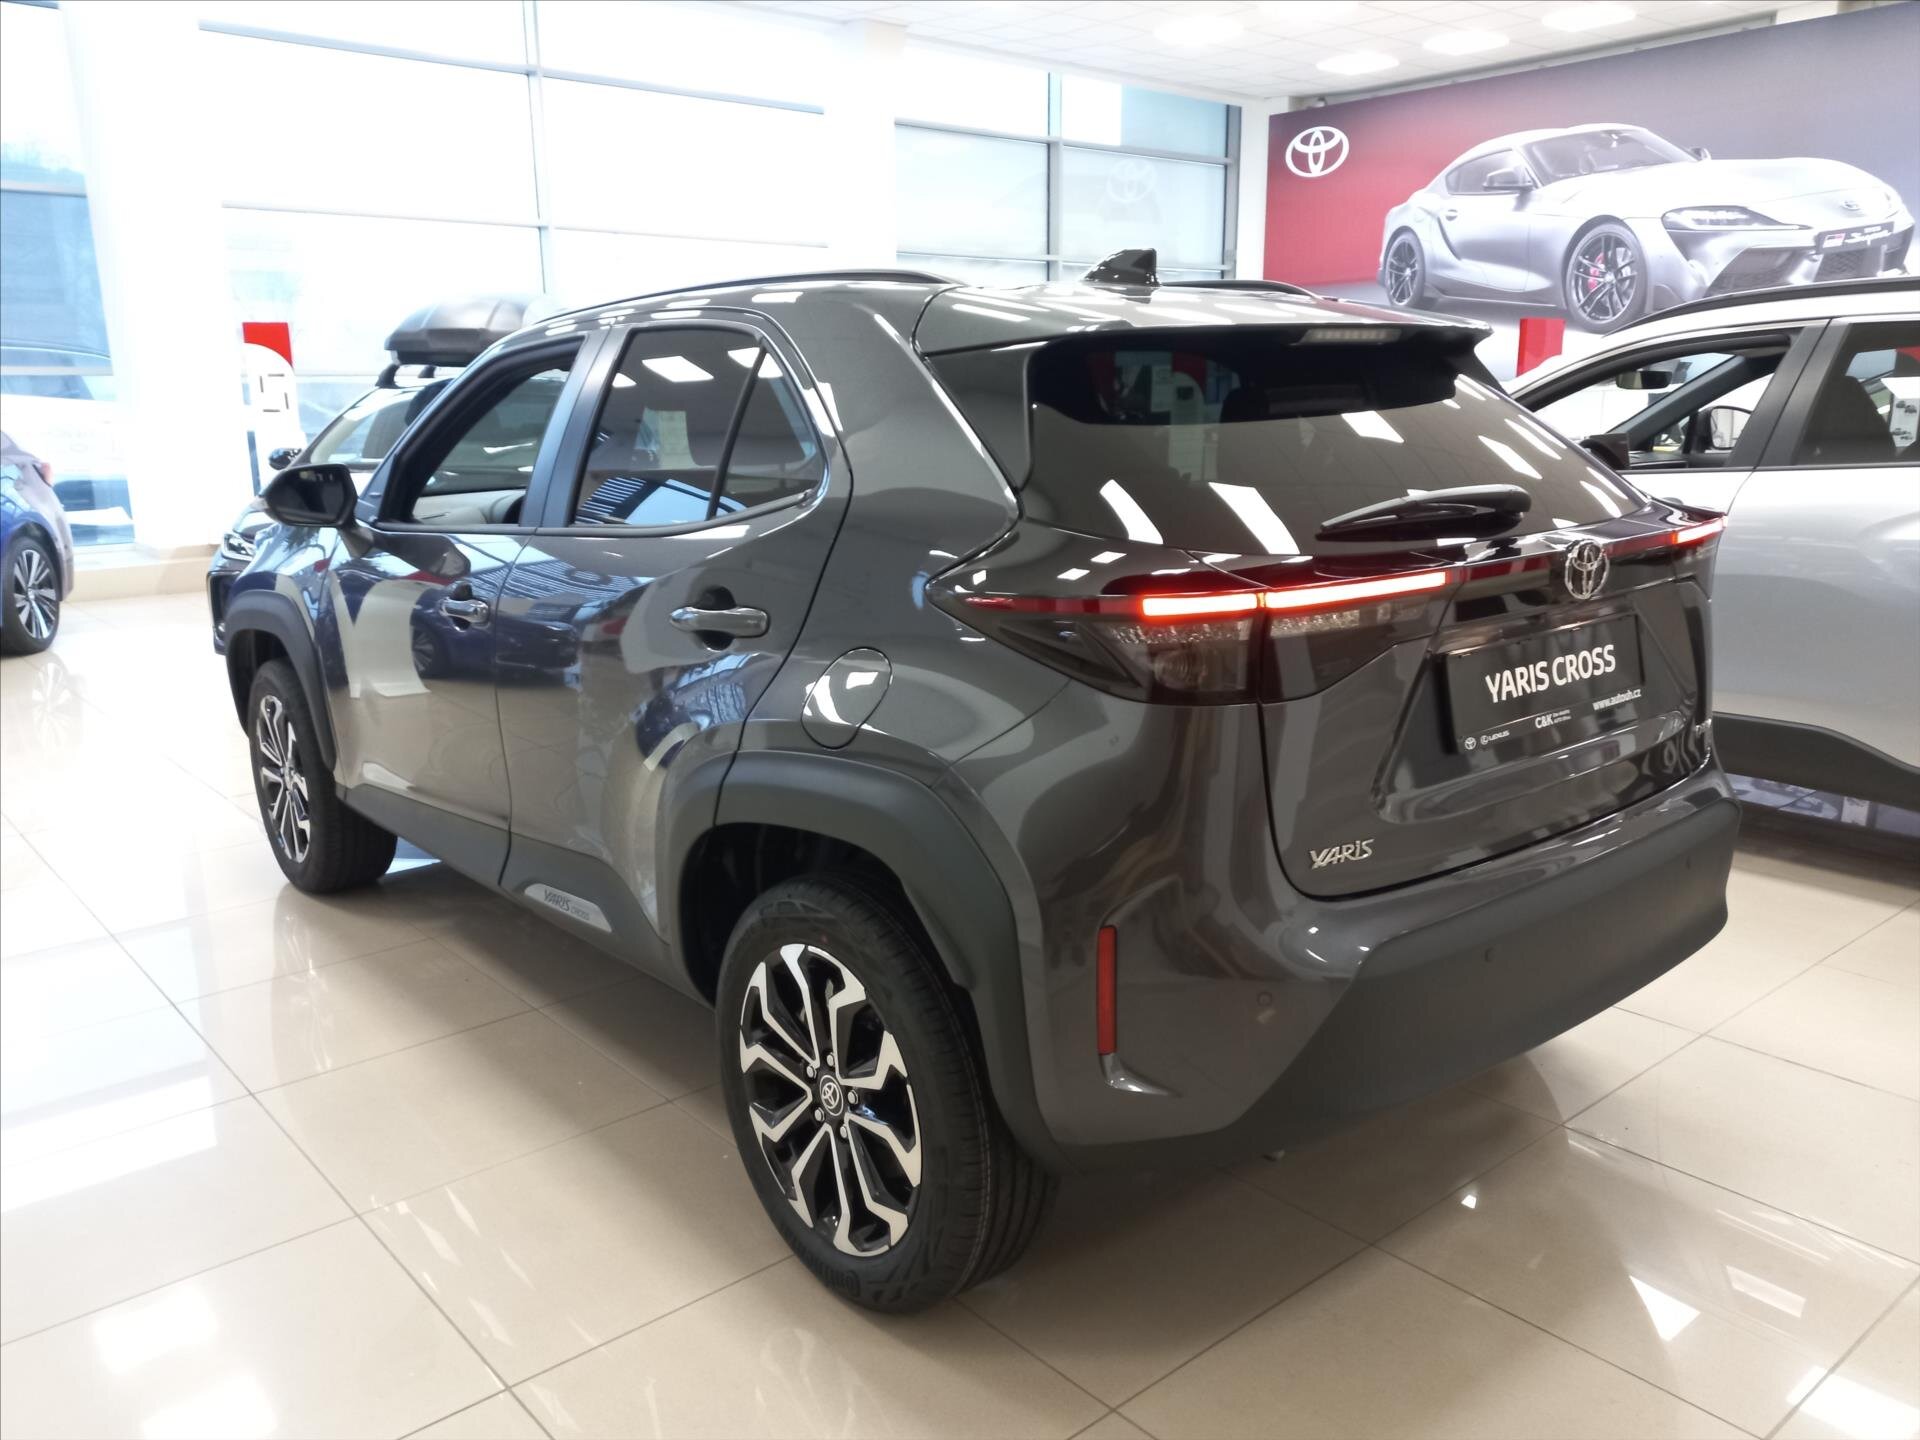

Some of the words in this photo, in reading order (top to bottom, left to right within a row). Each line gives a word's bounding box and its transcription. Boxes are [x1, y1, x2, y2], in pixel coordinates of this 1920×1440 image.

[1485, 661, 1550, 704] YARIS
[1552, 644, 1616, 686] CROSS
[1535, 713, 1554, 729] C&K
[1309, 838, 1375, 870] YARIS
[544, 889, 572, 912] YARIS
